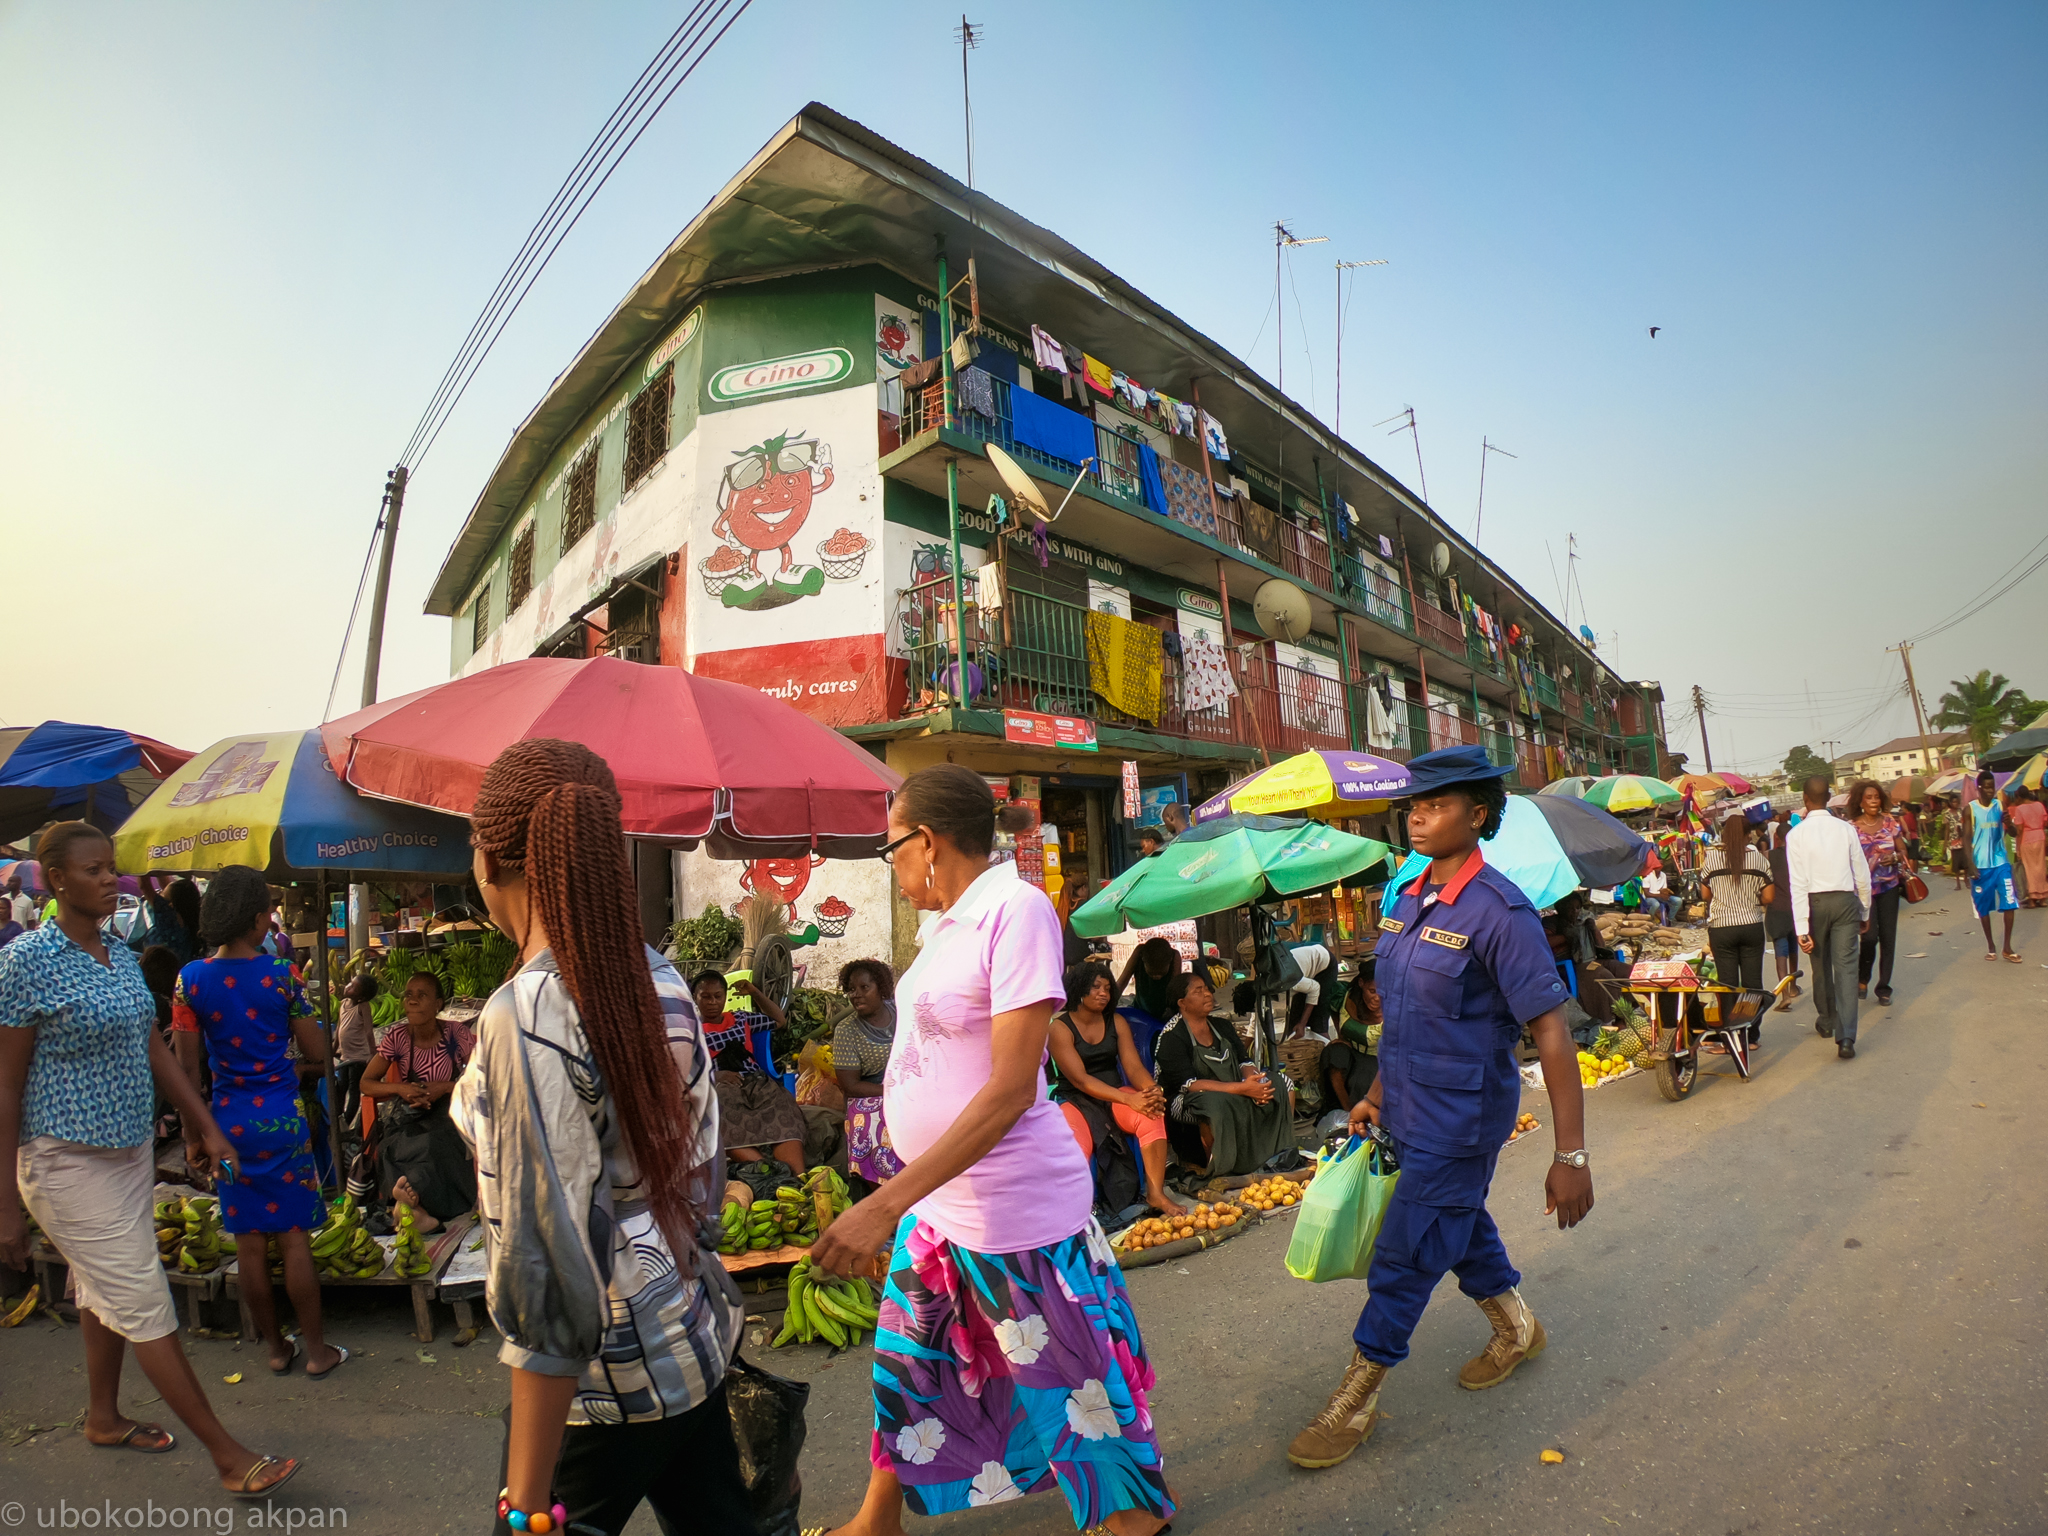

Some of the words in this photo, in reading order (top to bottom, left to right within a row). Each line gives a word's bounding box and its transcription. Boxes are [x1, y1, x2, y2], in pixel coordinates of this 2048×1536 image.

[656, 328, 686, 365] Gino
[961, 313, 1019, 353] HPPENS
[743, 363, 815, 387] Gino
[1062, 543, 1093, 566] WITH
[1095, 556, 1123, 577] GINO
[1189, 594, 1213, 611] Gino
[808, 679, 858, 696] cares
[1342, 781, 1360, 794] 100%
[1359, 781, 1374, 792] Pure
[1398, 778, 1407, 788] Oil
[147, 834, 198, 861] Healthy
[200, 825, 248, 846] Choice
[317, 836, 379, 858] Healthy
[382, 831, 439, 848] Choice
